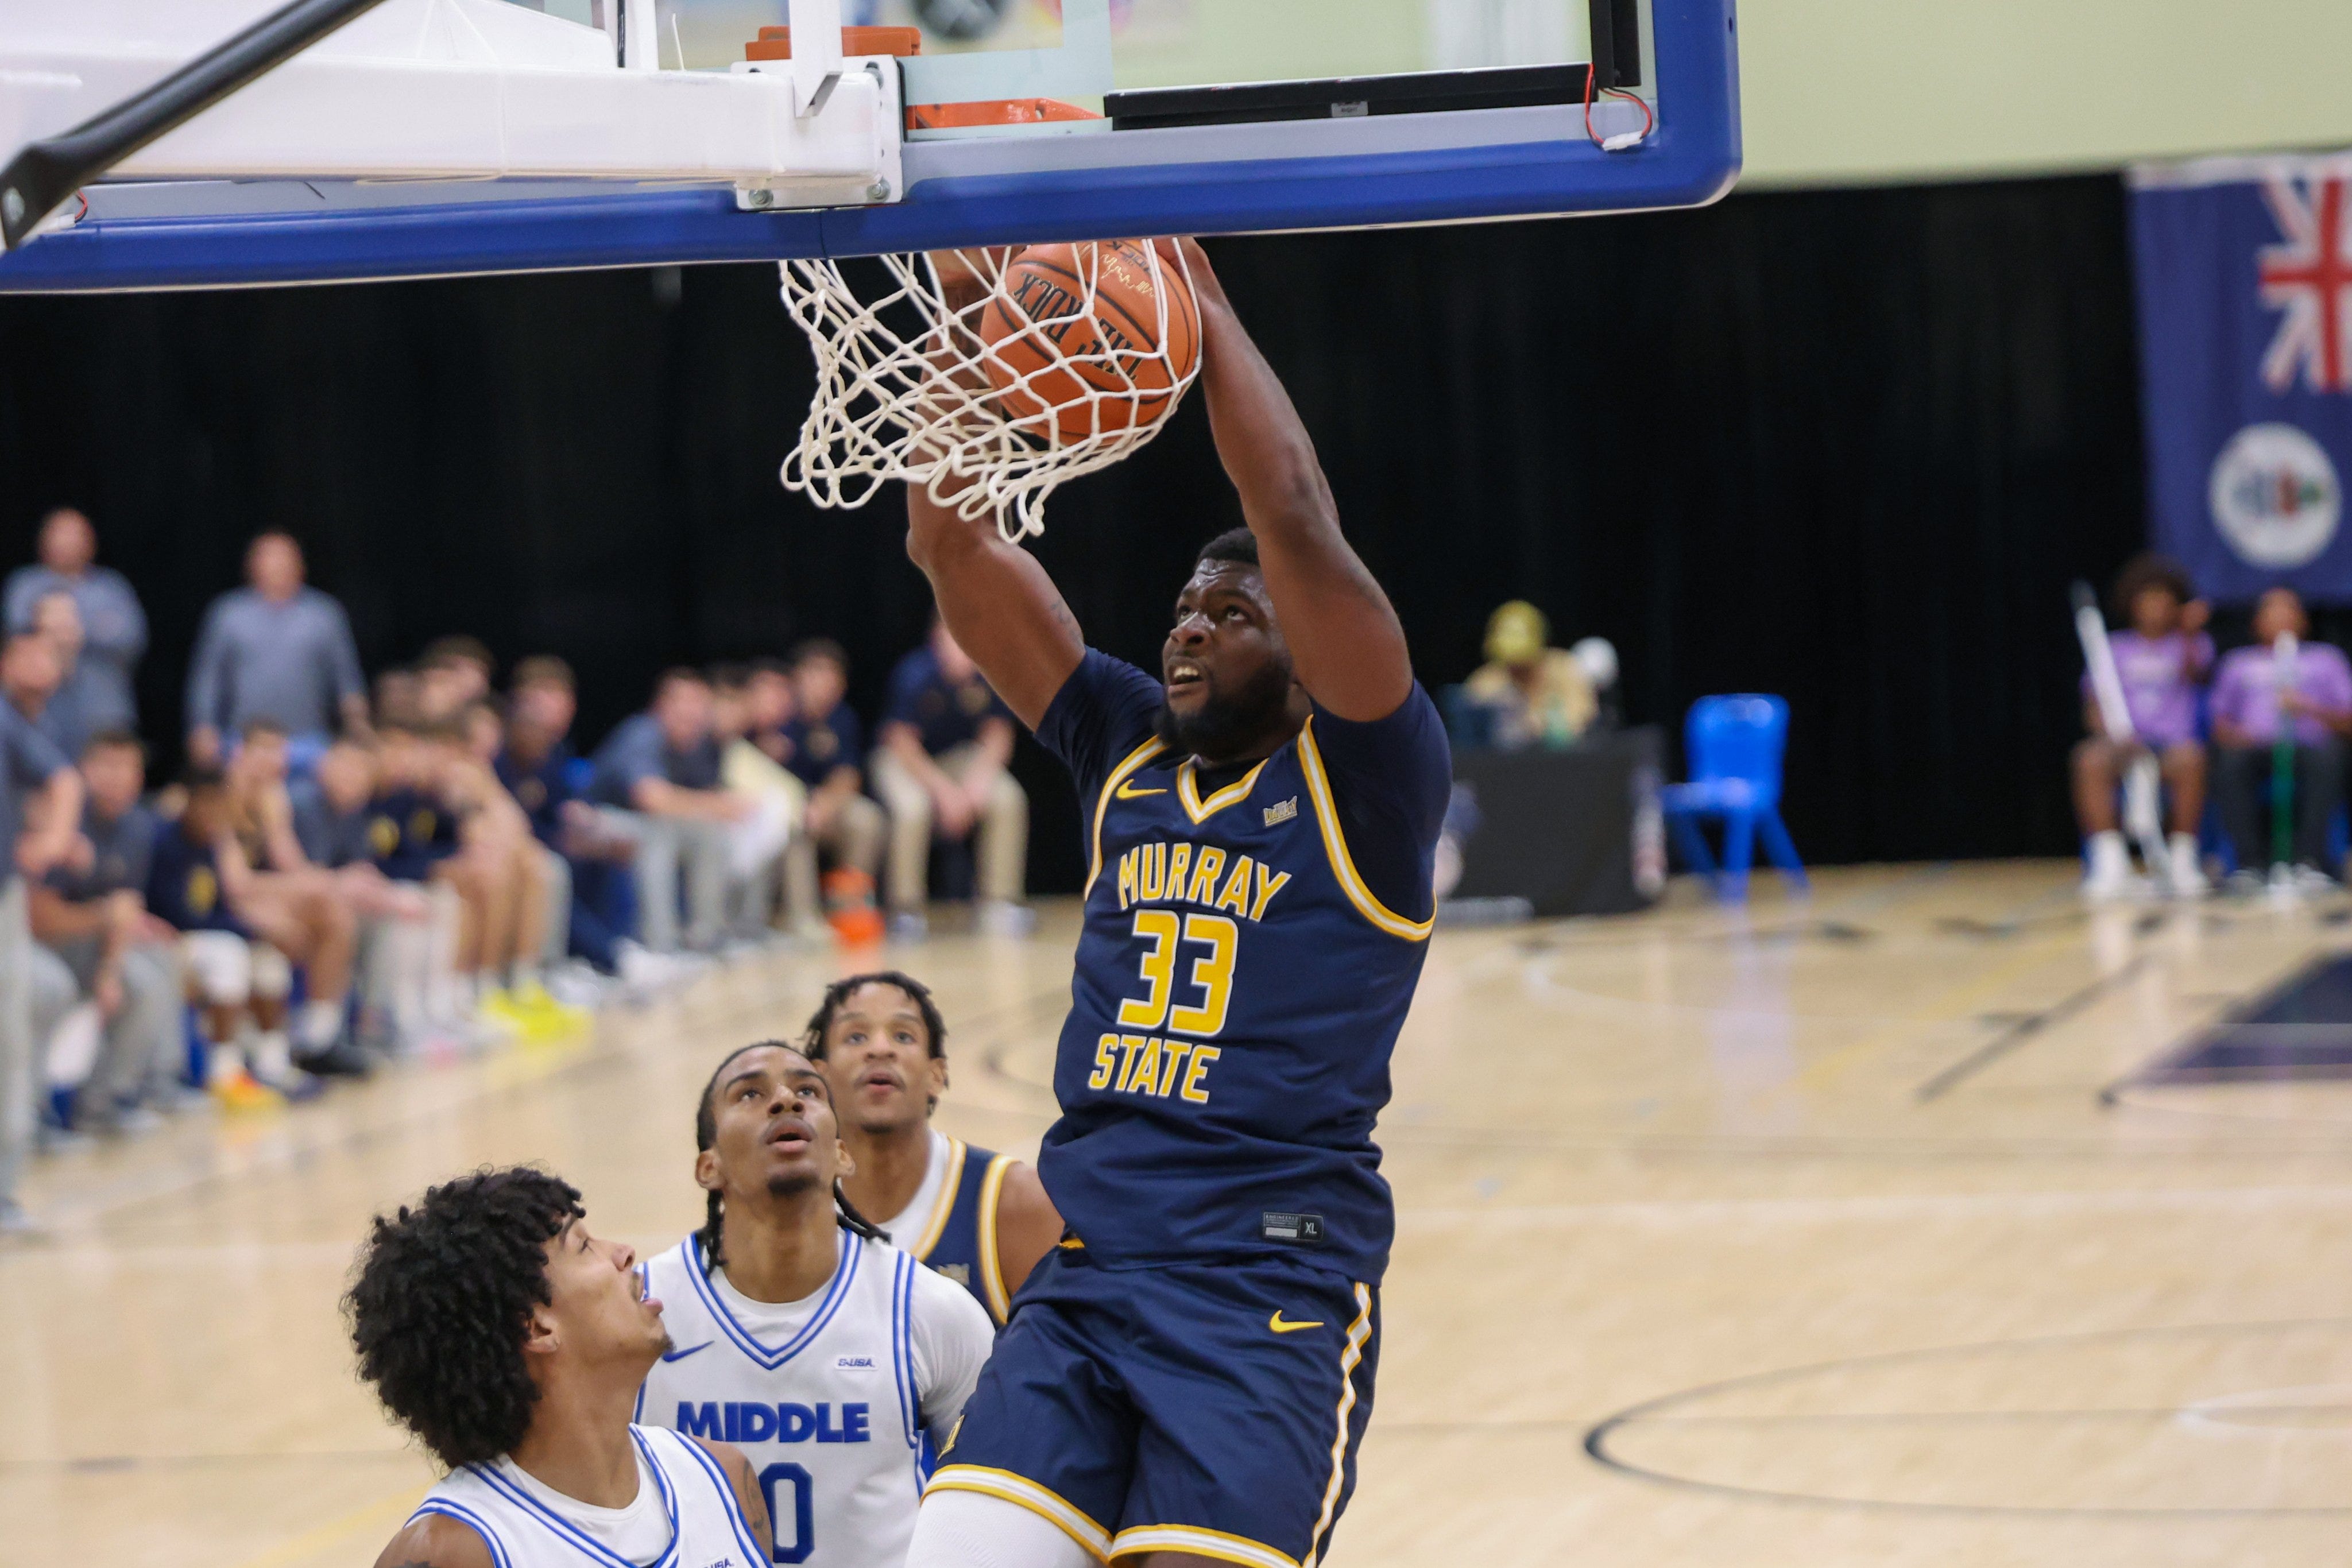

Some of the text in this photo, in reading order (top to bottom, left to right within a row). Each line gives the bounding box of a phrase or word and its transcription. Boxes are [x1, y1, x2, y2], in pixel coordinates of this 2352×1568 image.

[1013, 273, 1085, 344] ROCK
[1074, 317, 1143, 381] THE
[1118, 842, 1292, 923] MURRAY
[1116, 908, 1239, 1037] 33
[1088, 1033, 1221, 1104] STATE
[1305, 1221, 1317, 1234] XL
[676, 1400, 871, 1443] MIDDLE
[758, 1462, 815, 1564] 0
